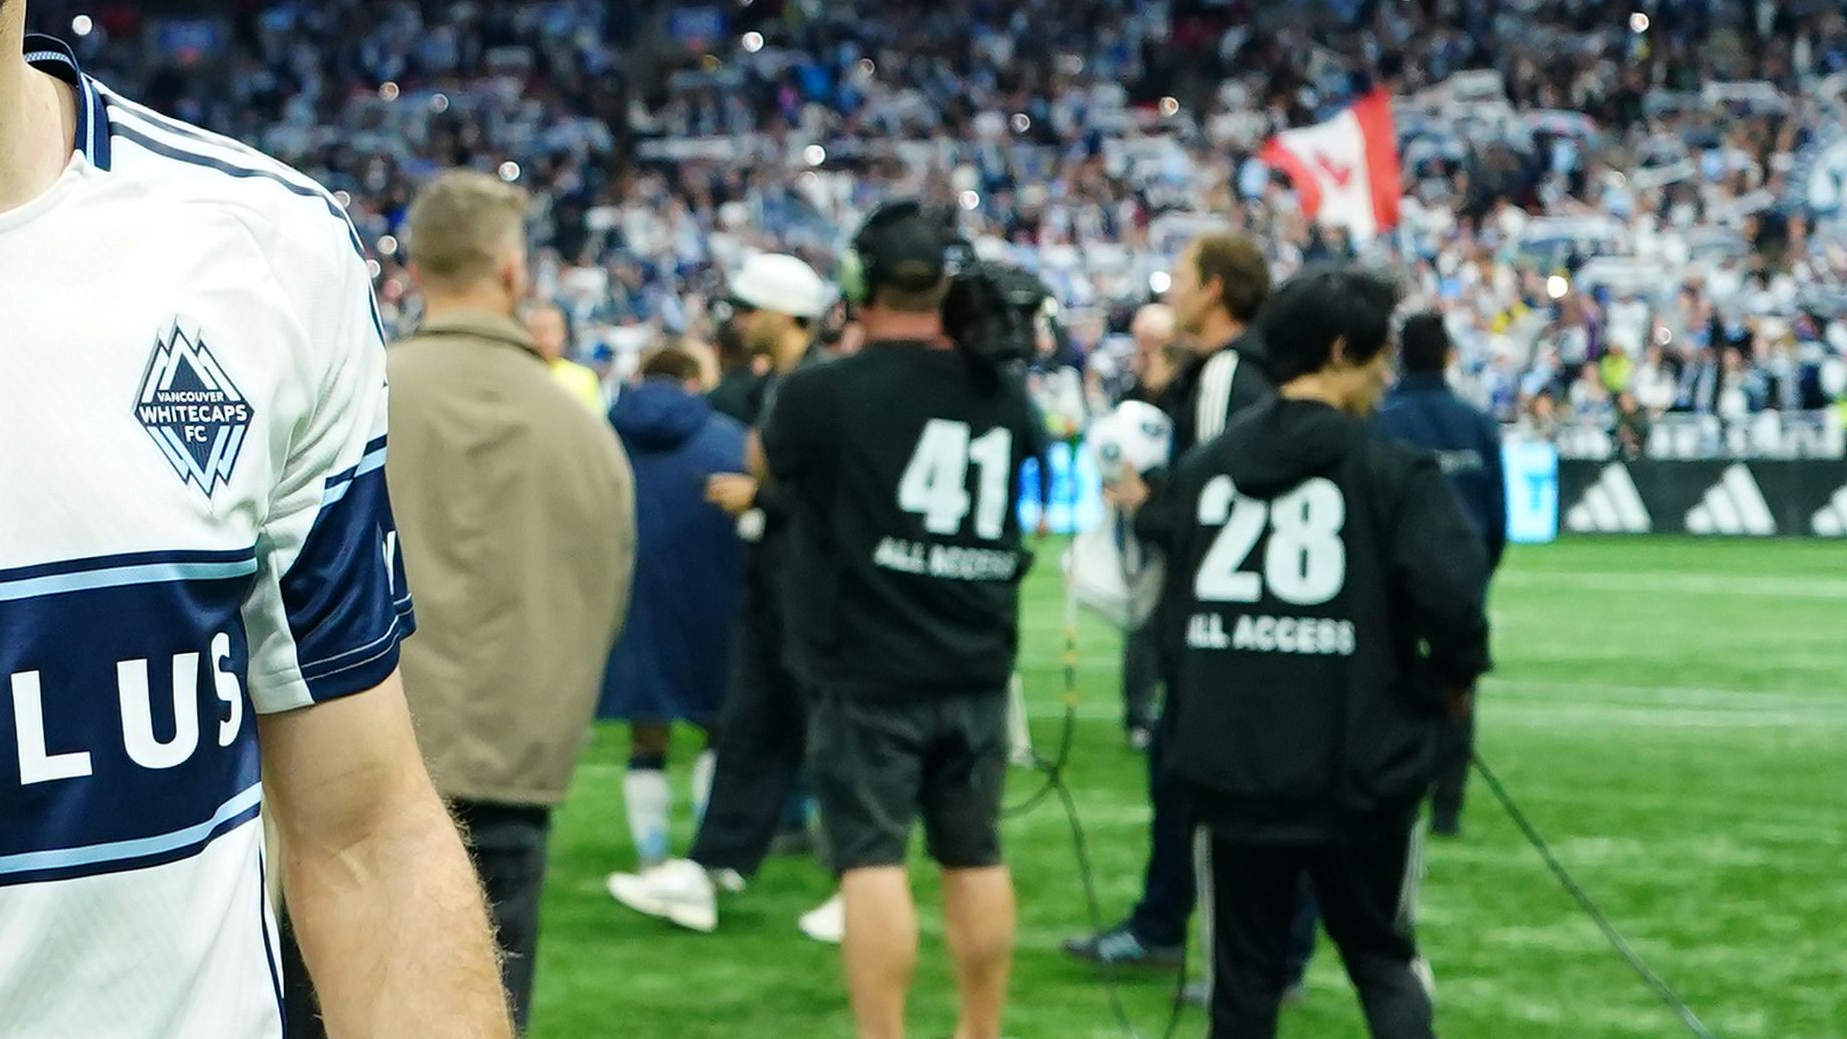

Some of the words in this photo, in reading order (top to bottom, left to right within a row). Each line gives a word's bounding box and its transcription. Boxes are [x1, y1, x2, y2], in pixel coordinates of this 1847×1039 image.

[157, 391, 224, 402] VANCOUVER
[138, 404, 248, 424] WHITECAPS
[183, 425, 208, 443] FC
[898, 418, 1014, 541] 41
[1194, 473, 1347, 606] 28
[873, 537, 926, 574] ALL
